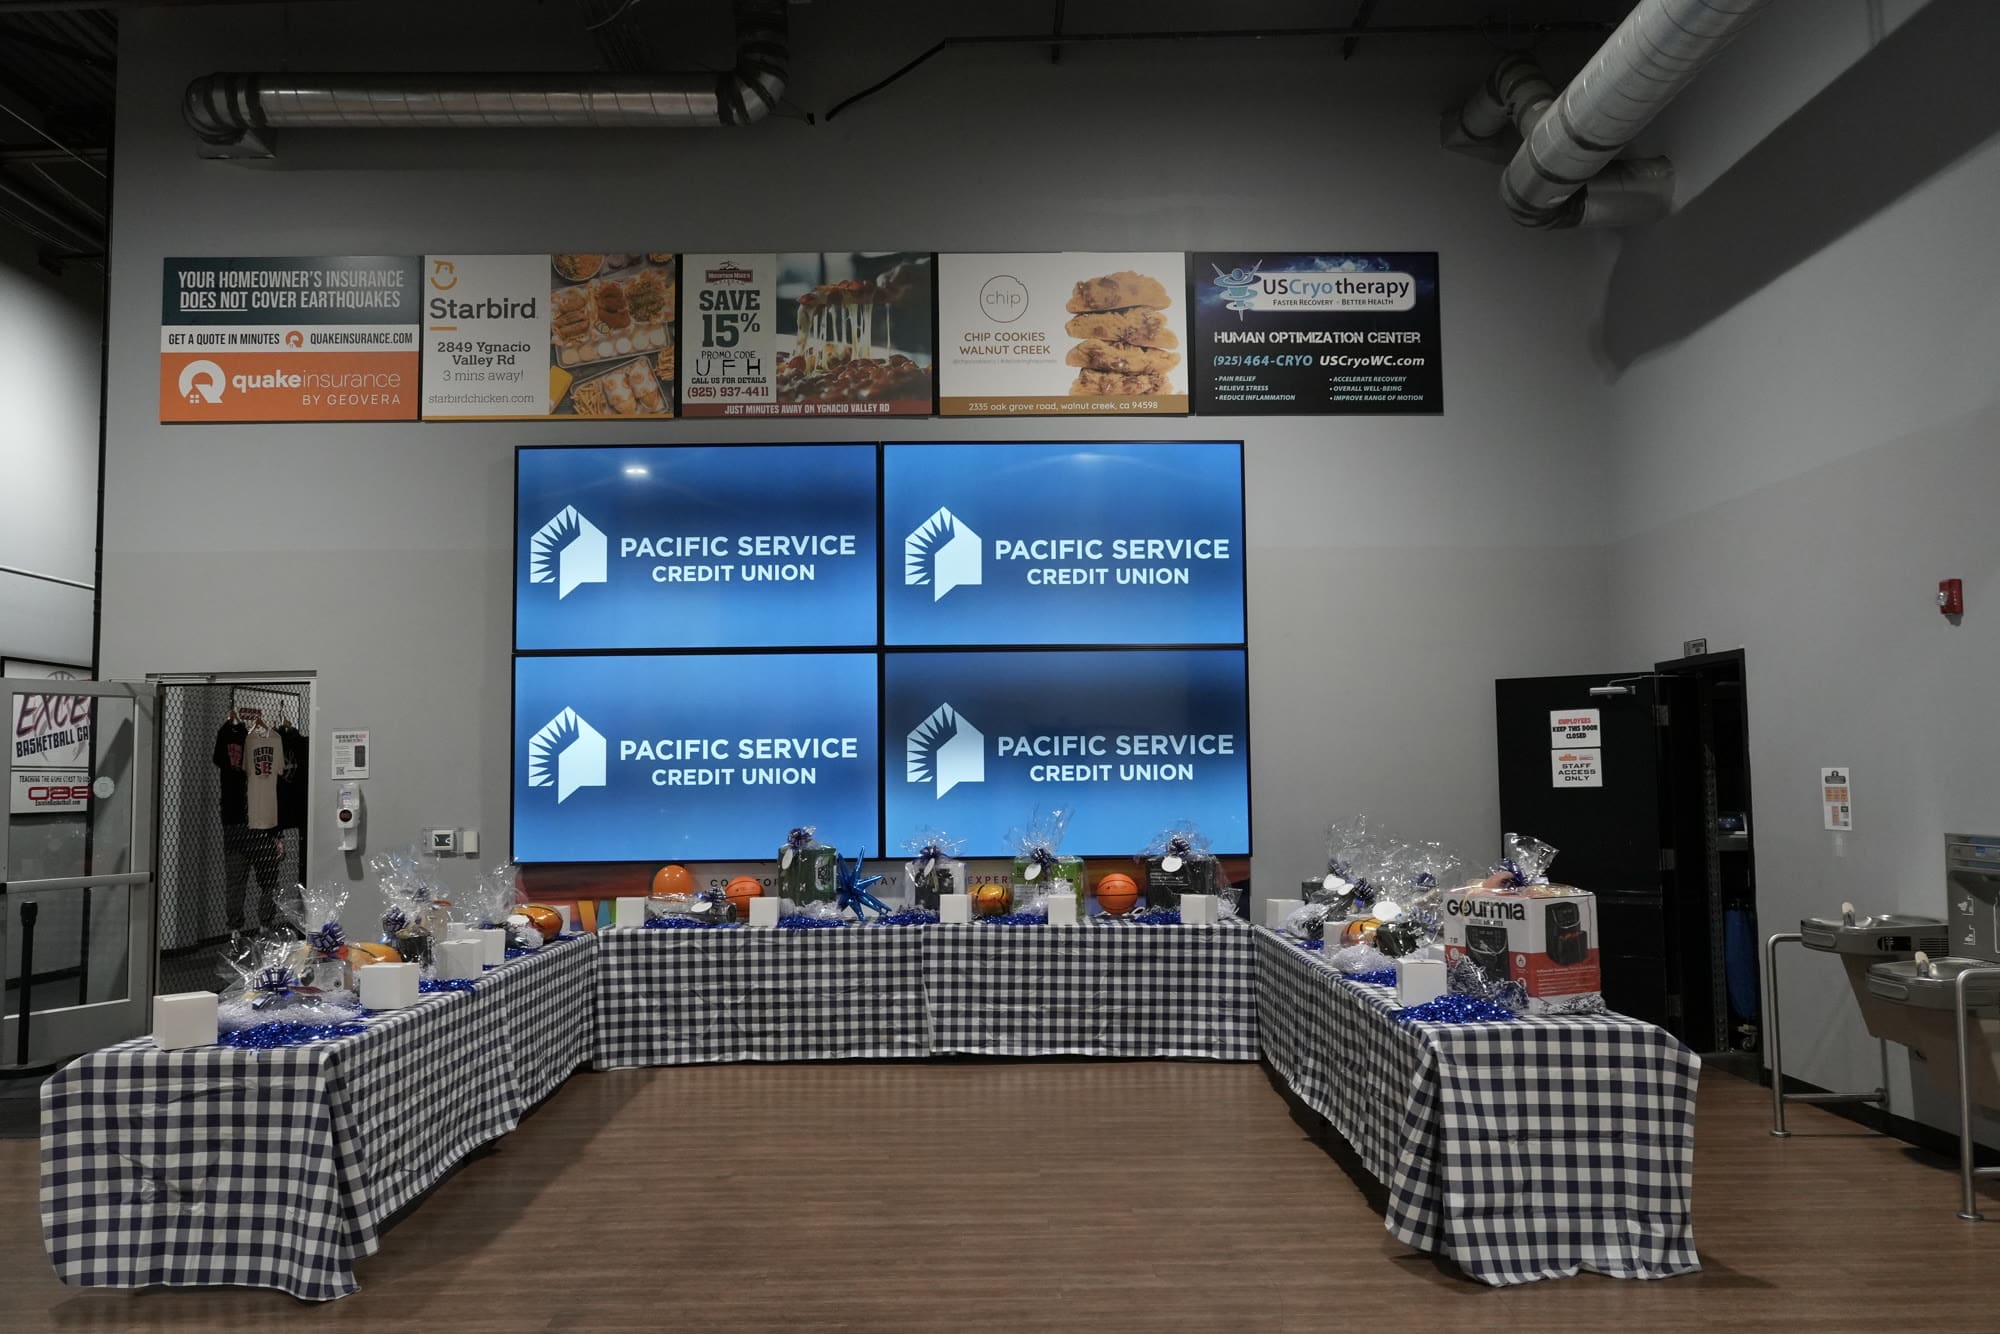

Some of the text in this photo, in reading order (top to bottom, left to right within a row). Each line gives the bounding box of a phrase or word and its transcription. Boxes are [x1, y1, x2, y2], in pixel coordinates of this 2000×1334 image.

[178, 270, 404, 288] YOUR HOMEOWNER'S INSURANCE
[1263, 278, 1409, 298] USCryotherapy
[180, 290, 400, 308] DOES NOT COVER EARTHQUAKES
[699, 290, 760, 311] SAVE
[986, 290, 1021, 308] chip
[429, 297, 537, 319] Starbird
[168, 333, 280, 345] GET A QUOTE IN MINUTES
[310, 333, 413, 344] QUAKEINSURANCE.COM
[701, 313, 760, 348] 15%
[964, 332, 1045, 342] CHIP COOKIES
[1214, 331, 1421, 344] HUMAN OPTIMIZATION CENTER
[437, 341, 531, 355] 2849 Ygnacio
[701, 350, 756, 360] PROMO CODE
[959, 345, 1051, 355] WALNUT CREEK
[452, 354, 515, 367] Valley Rd
[1319, 355, 1425, 368] USCryoWC.com
[232, 369, 401, 393] quakeinsurance
[443, 370, 524, 384] 3 mins away!
[302, 394, 401, 405] BY GEOVERA
[428, 393, 535, 405] starbirdchicken.com
[687, 387, 769, 398] (925) 937-4411
[724, 404, 890, 414] JUST MINUTES AWAY ON YGNACIO VALLEY RD
[969, 402, 988, 411] 2335
[990, 402, 1007, 411] oak
[1009, 403, 1034, 412] grove
[1036, 402, 1058, 411] road,
[1061, 401, 1089, 410] walnut
[1132, 401, 1158, 409] 94598
[620, 535, 856, 558] PACIFIC SERVICE
[995, 539, 1230, 560] PACIFIC SERVICE
[652, 564, 815, 582] CREDIT UNION
[1027, 568, 1189, 585] CREDIT UNION
[16, 729, 75, 758] BASKETBALL
[620, 738, 858, 761] PACIFIC SERVICE
[998, 734, 1234, 757] PACIFIC SERVICE
[652, 767, 816, 786] CREDIT UNION
[1030, 764, 1193, 782] CREDIT UNION
